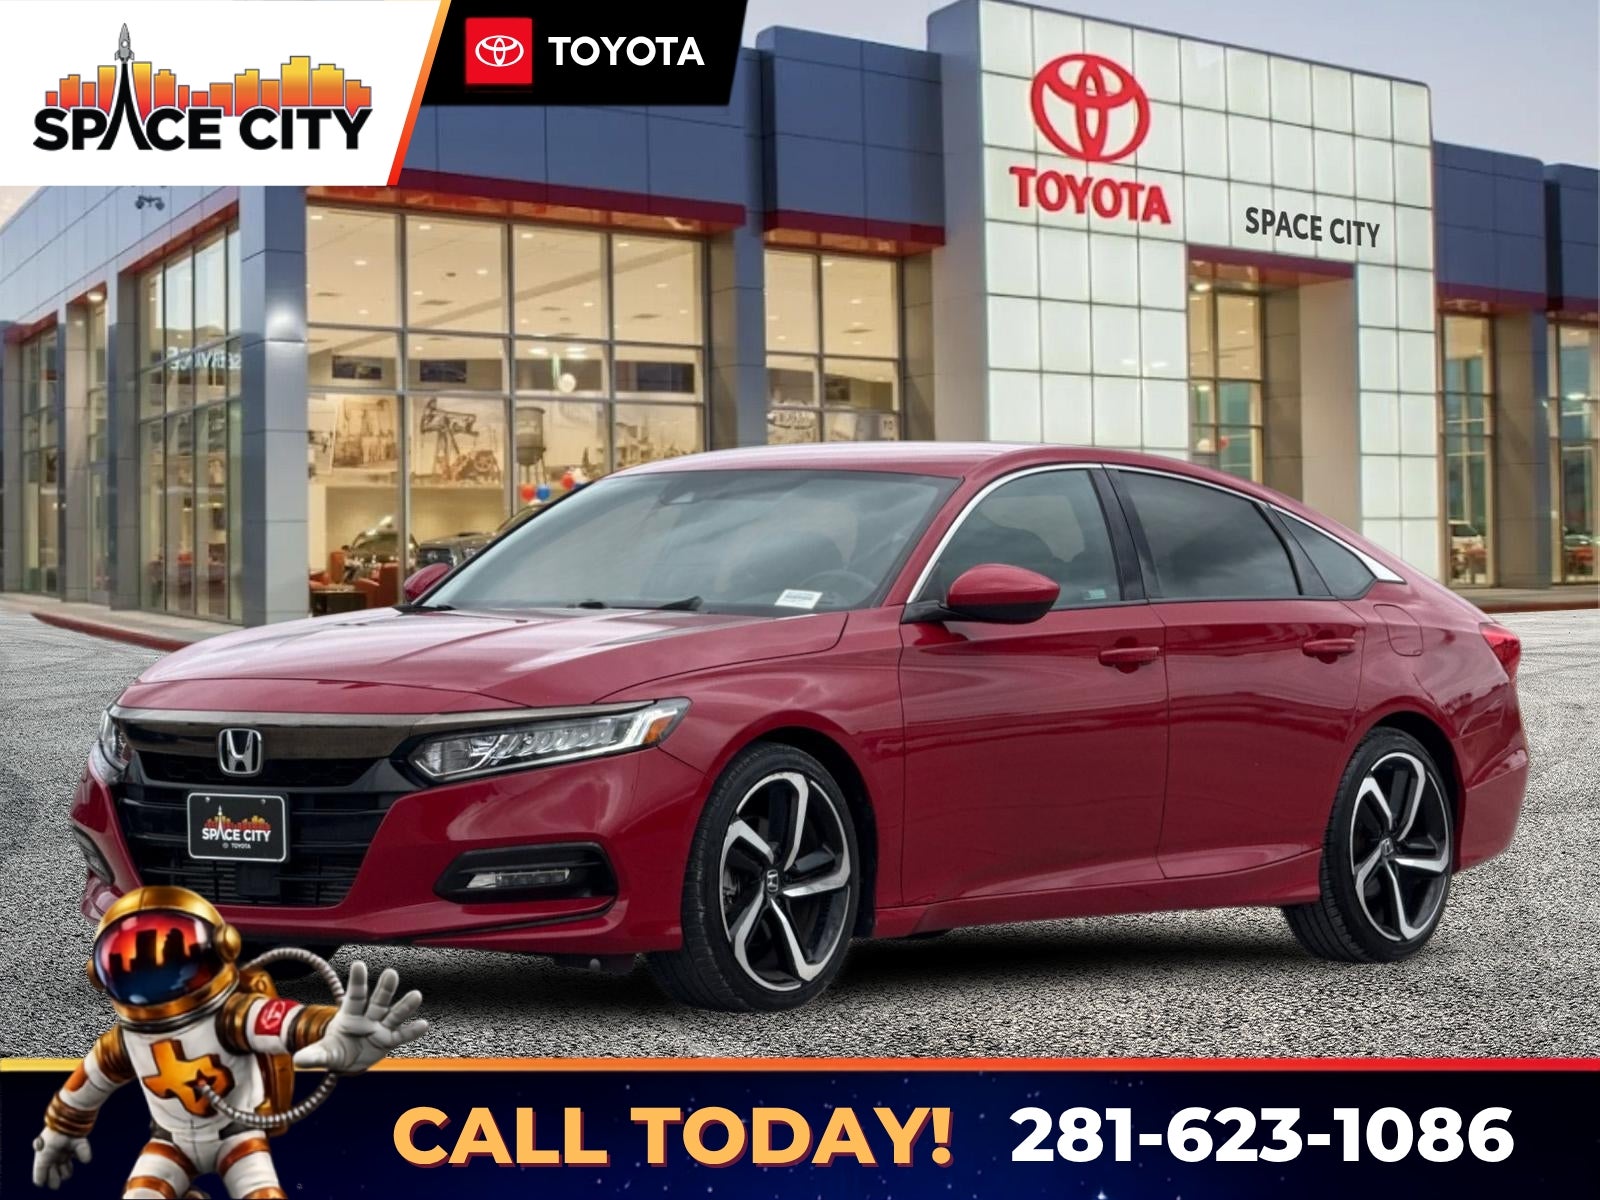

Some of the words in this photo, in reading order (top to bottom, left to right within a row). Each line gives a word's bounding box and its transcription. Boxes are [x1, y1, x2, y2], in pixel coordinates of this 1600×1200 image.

[1009, 166, 1171, 224] TOYOTA
[1245, 207, 1322, 241] SPACE
[1329, 218, 1380, 248] CITY
[201, 827, 241, 841] SPACE
[243, 830, 271, 842] CITY
